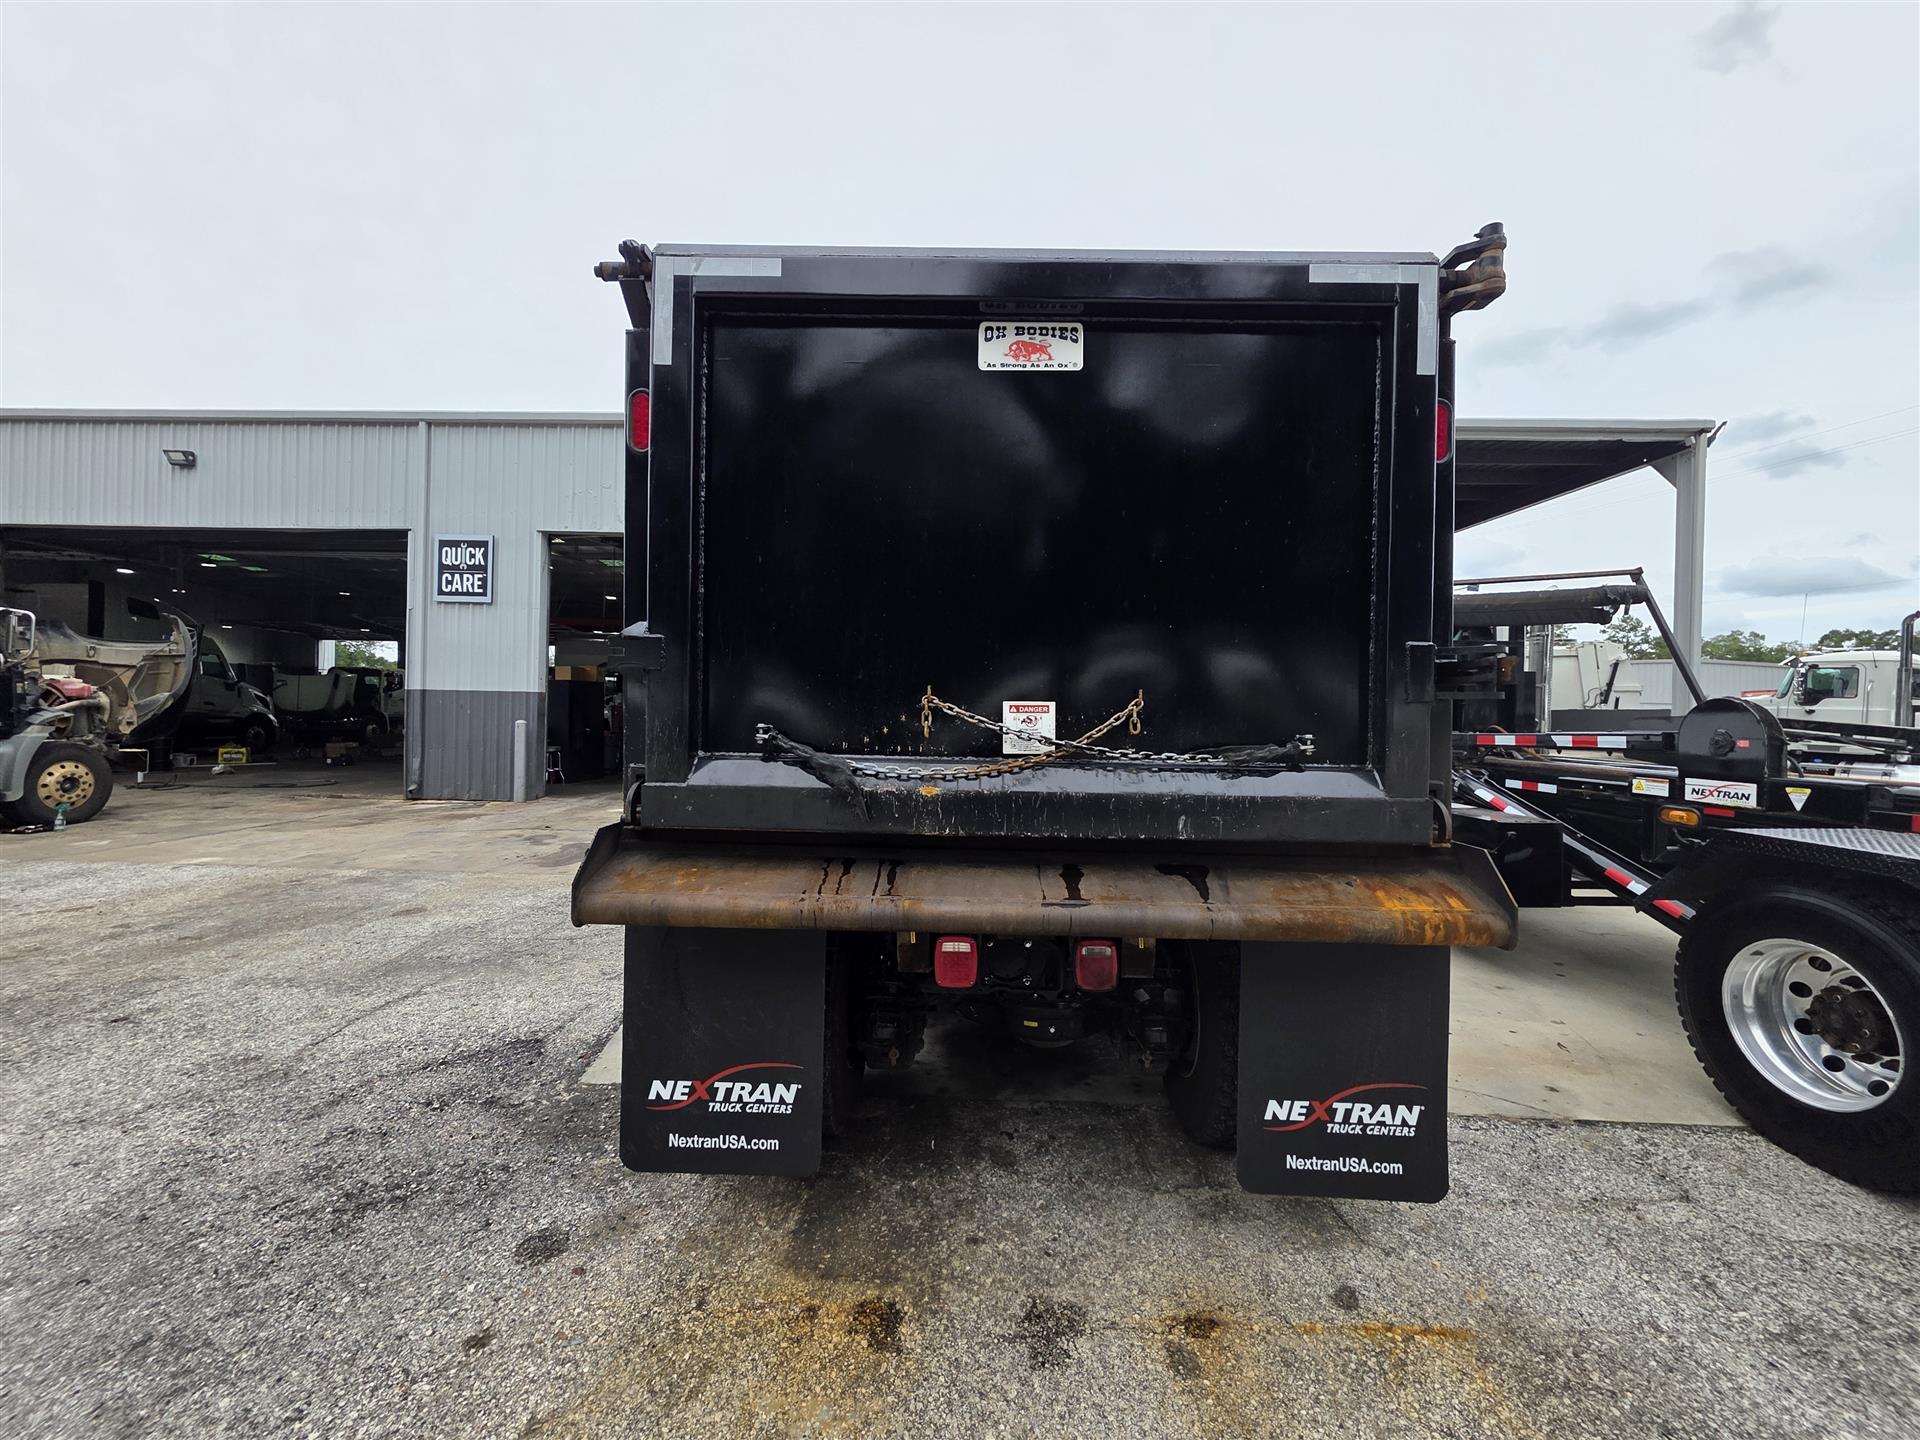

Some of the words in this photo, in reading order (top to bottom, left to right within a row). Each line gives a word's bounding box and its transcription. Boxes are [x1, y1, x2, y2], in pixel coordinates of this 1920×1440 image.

[984, 326, 1007, 342] OX
[1014, 326, 1079, 344] BODIES
[442, 544, 485, 568] QUICK
[442, 573, 484, 593] CARE
[1691, 787, 1751, 801] NEXTRAN
[648, 1079, 798, 1104] NEXTRAN
[708, 1103, 742, 1112] TRUCK
[746, 1103, 793, 1114] CENTERS
[1264, 1099, 1421, 1126] NEXTRAN
[1326, 1123, 1363, 1135] TRUCK
[1366, 1125, 1416, 1137] CENTERS
[669, 1133, 779, 1150] NextranUSA.com
[1286, 1154, 1403, 1175] NextranUSA.com
